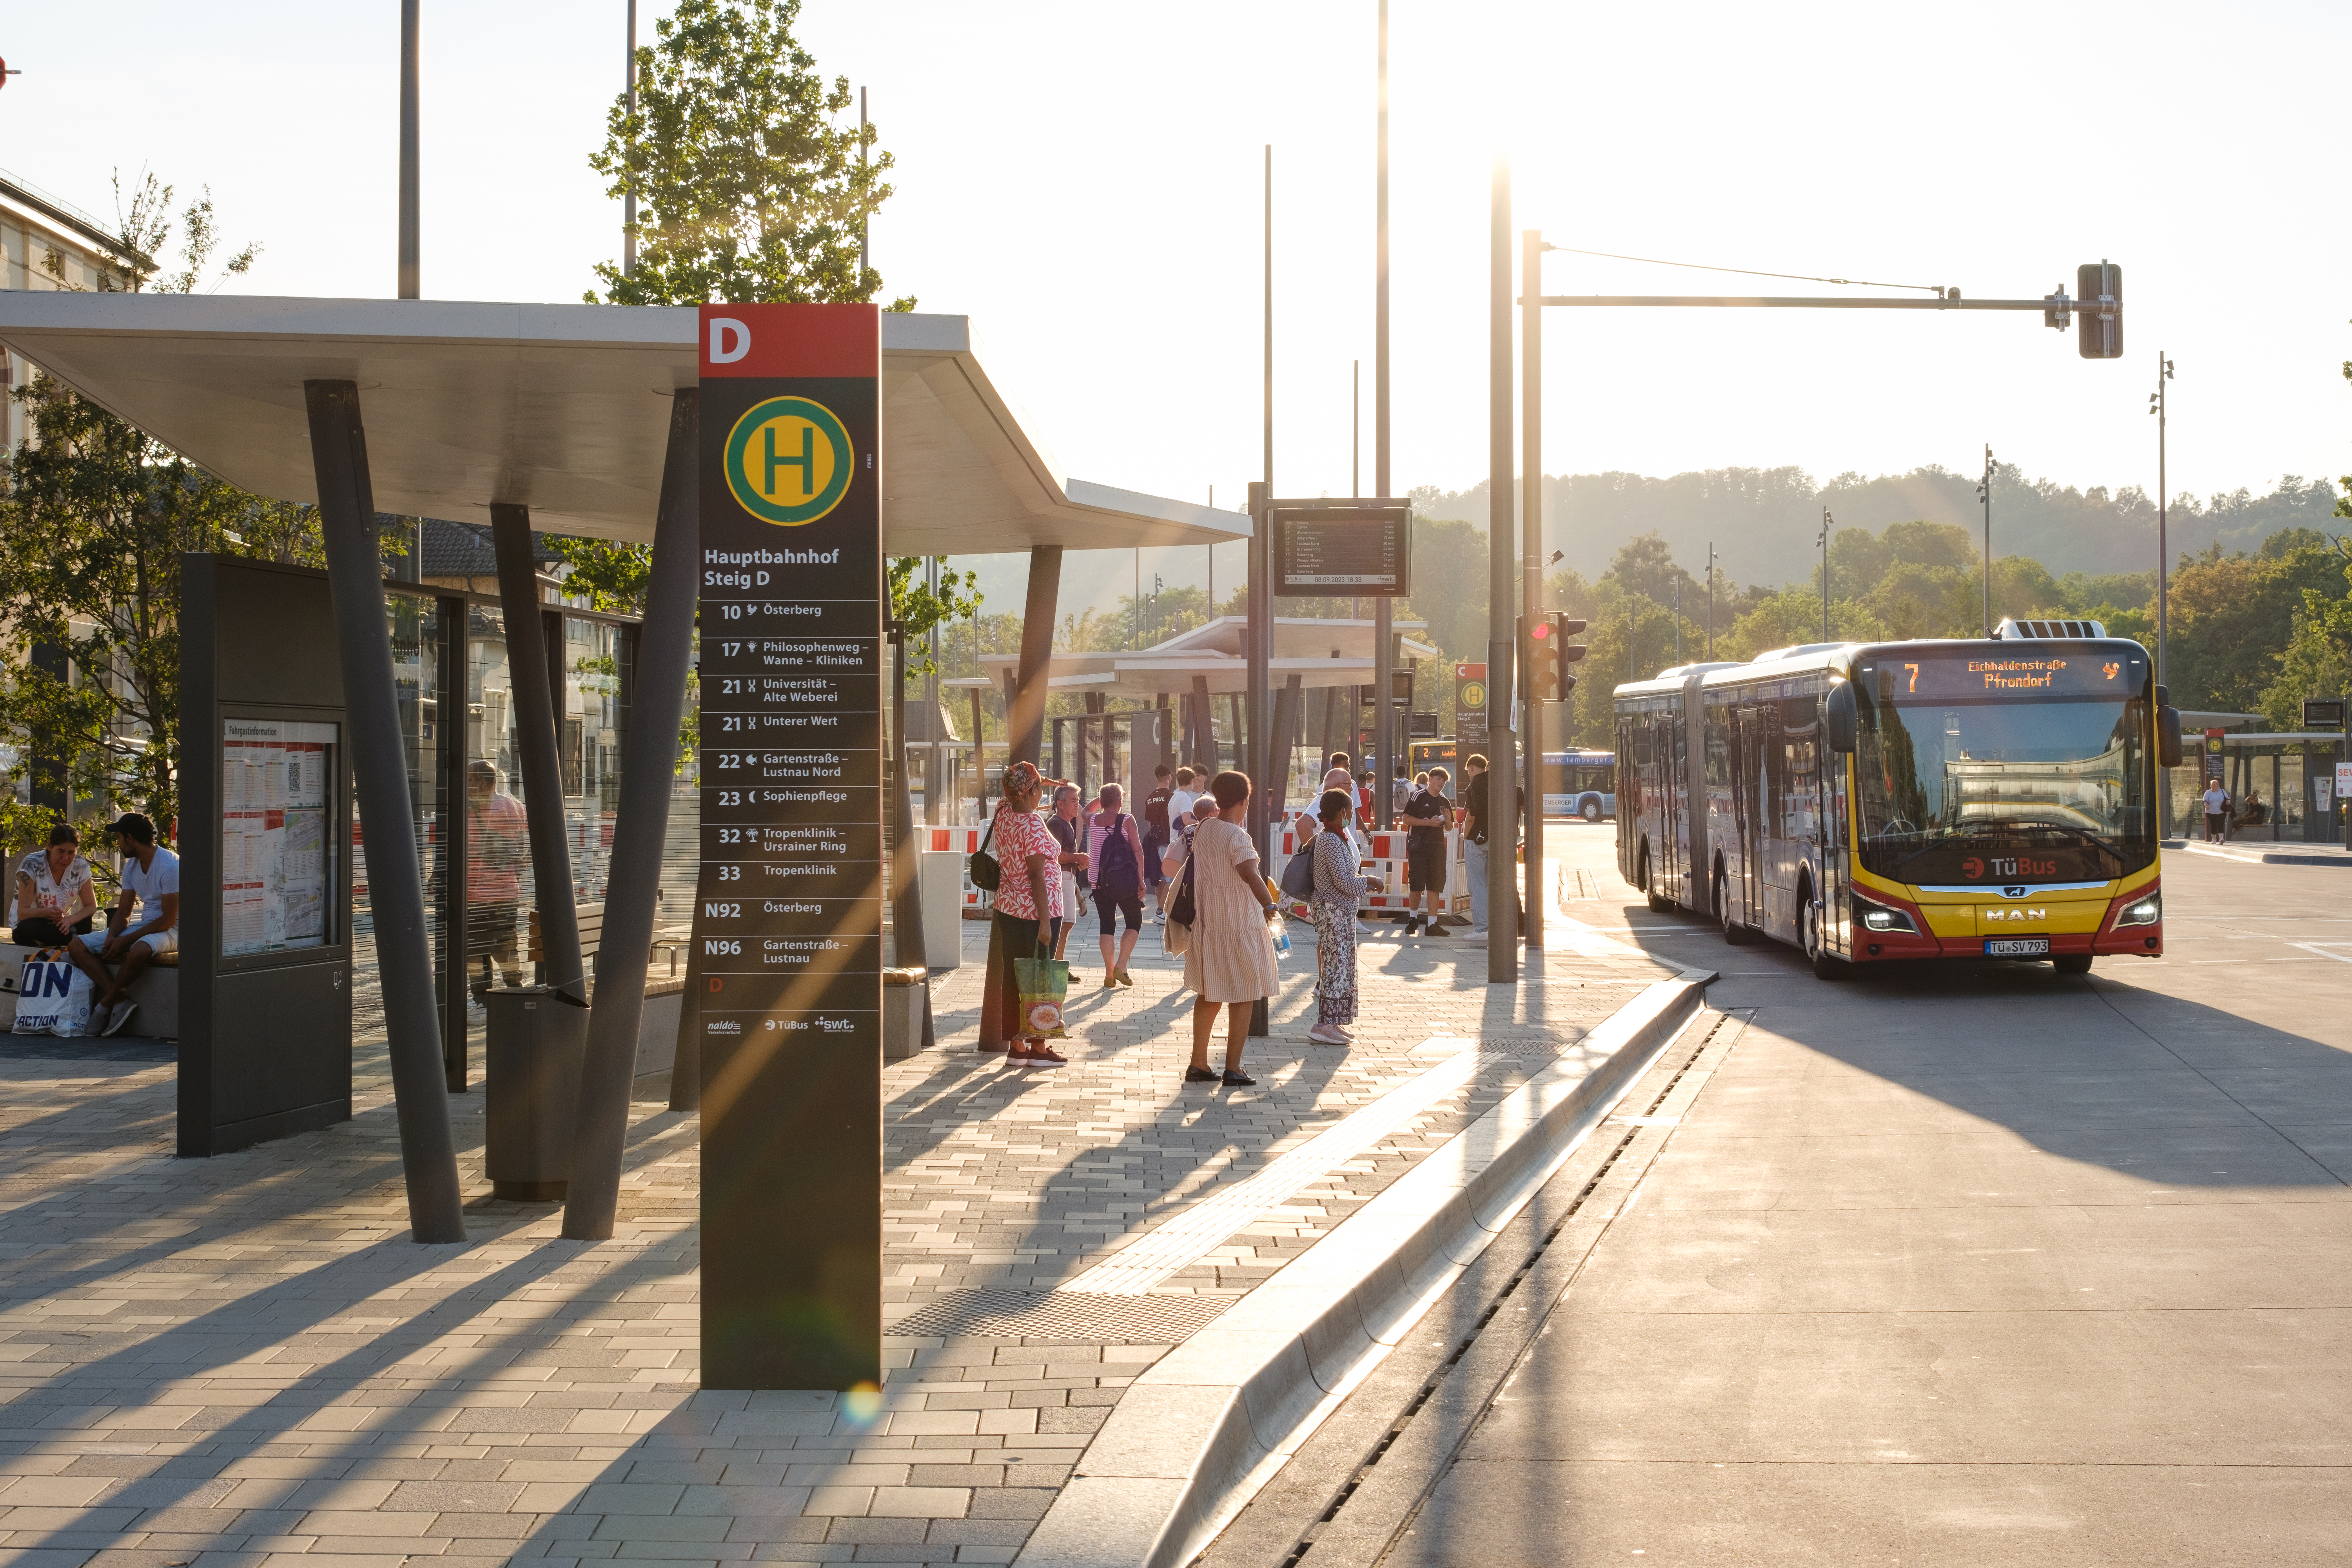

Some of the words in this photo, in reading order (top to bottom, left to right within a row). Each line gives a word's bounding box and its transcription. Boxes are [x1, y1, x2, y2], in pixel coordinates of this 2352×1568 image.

[710, 318, 751, 363] D
[765, 427, 813, 494] H
[706, 549, 839, 567] Hauptbahnhof
[705, 571, 750, 589] Steig
[757, 571, 769, 585] D
[722, 606, 740, 619] 10
[764, 603, 821, 617] Österberg
[722, 643, 740, 656] 17
[764, 642, 859, 654] Philosophenweg
[764, 656, 803, 664] Wanne
[817, 655, 862, 664] Kliniken
[1968, 660, 2066, 671] Eichhaldenstraße
[1458, 666, 1466, 676] C
[1905, 664, 1918, 692] 7
[723, 680, 740, 693] 21
[764, 679, 827, 688] Universität
[1985, 673, 2052, 688] Pfrondorf
[764, 692, 786, 701] Alte
[790, 692, 837, 701] Weberei
[1470, 688, 1479, 702] H
[723, 717, 740, 730] 21
[764, 717, 808, 726] Unterer
[811, 716, 837, 725] Wert
[229, 726, 277, 737] Fahrgastinformation
[1424, 748, 1428, 757] 2
[719, 755, 740, 768] 22
[764, 753, 838, 763] Gartenstraße
[764, 768, 809, 776] Lustnau
[813, 767, 840, 776] Nord
[719, 792, 740, 805] 23
[764, 791, 847, 802] Sophienpflege
[720, 829, 740, 843] 32
[764, 828, 836, 840] Tropenklinik
[764, 842, 817, 851] Ursrainer
[821, 842, 846, 853] Ring
[719, 866, 740, 880] 33
[764, 865, 837, 877] Tropenklinik
[1991, 858, 2056, 875] TüBus
[706, 904, 740, 917] N92
[764, 901, 821, 914] Österberg
[1986, 909, 2045, 921] MAN
[706, 941, 741, 955] N96
[764, 940, 839, 949] Gartenstraße
[1991, 942, 2004, 952] TÜ
[2012, 942, 2025, 952] SV
[2027, 941, 2047, 951] 793
[764, 954, 809, 963] Lustnau
[710, 978, 722, 992] D
[18, 1015, 58, 1027] ACTION
[778, 1020, 808, 1029] TüBus
